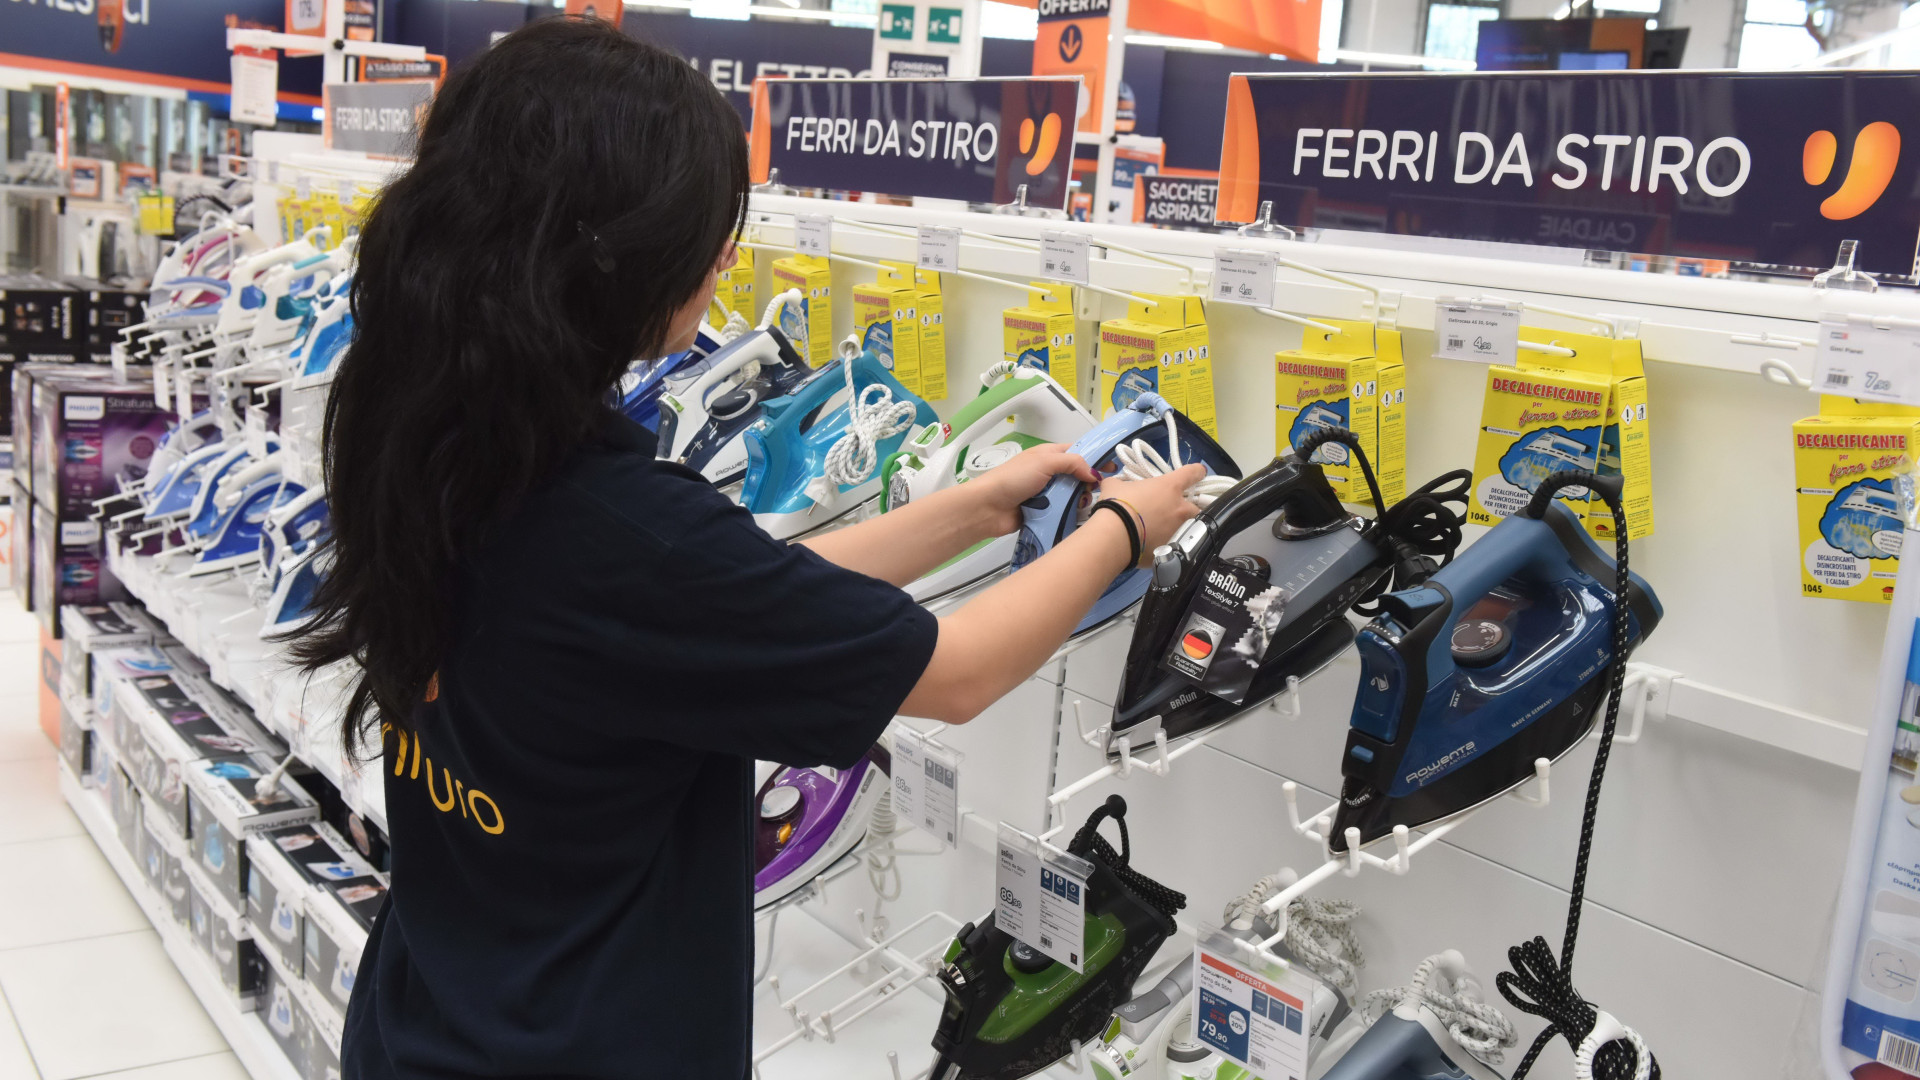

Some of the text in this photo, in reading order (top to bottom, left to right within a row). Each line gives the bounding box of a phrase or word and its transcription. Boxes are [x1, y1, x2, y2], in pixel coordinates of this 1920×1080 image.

[336, 106, 362, 130] FERRI
[363, 108, 378, 131] DA
[786, 116, 999, 163] FERRI DA STIRO
[1293, 128, 1751, 198] FERRI DA STIRO
[1278, 361, 1347, 380] DECALCIFICANTE
[1492, 377, 1602, 405] DECALCIFICANTE
[1532, 401, 1543, 409] per
[1518, 407, 1600, 428] ferro stiro
[1797, 433, 1907, 449] DECALCIFICANTE
[1839, 454, 1849, 462] per
[1829, 462, 1866, 484] ferro
[1489, 495, 1529, 506] DISINCROSTANTE
[1491, 488, 1529, 499] DECALCIFICANTE
[1470, 512, 1490, 522] 1045
[1817, 555, 1855, 563] DECALCIFICANTE
[1817, 562, 1856, 571] DISINCROSTANTE
[1208, 569, 1246, 599] BRAUN
[1803, 584, 1823, 593] 1045
[1204, 585, 1233, 605] TexStyle
[1174, 655, 1203, 673] Guaranteed
[1170, 691, 1198, 710] BRAUN
[1453, 692, 1461, 708] MAX
[1511, 716, 1525, 728] MADE
[1531, 698, 1553, 715] GERMANY
[1235, 971, 1267, 991] OFFERTA
[1201, 1019, 1227, 1043] 79,90
[1231, 1021, 1244, 1031] 20%
